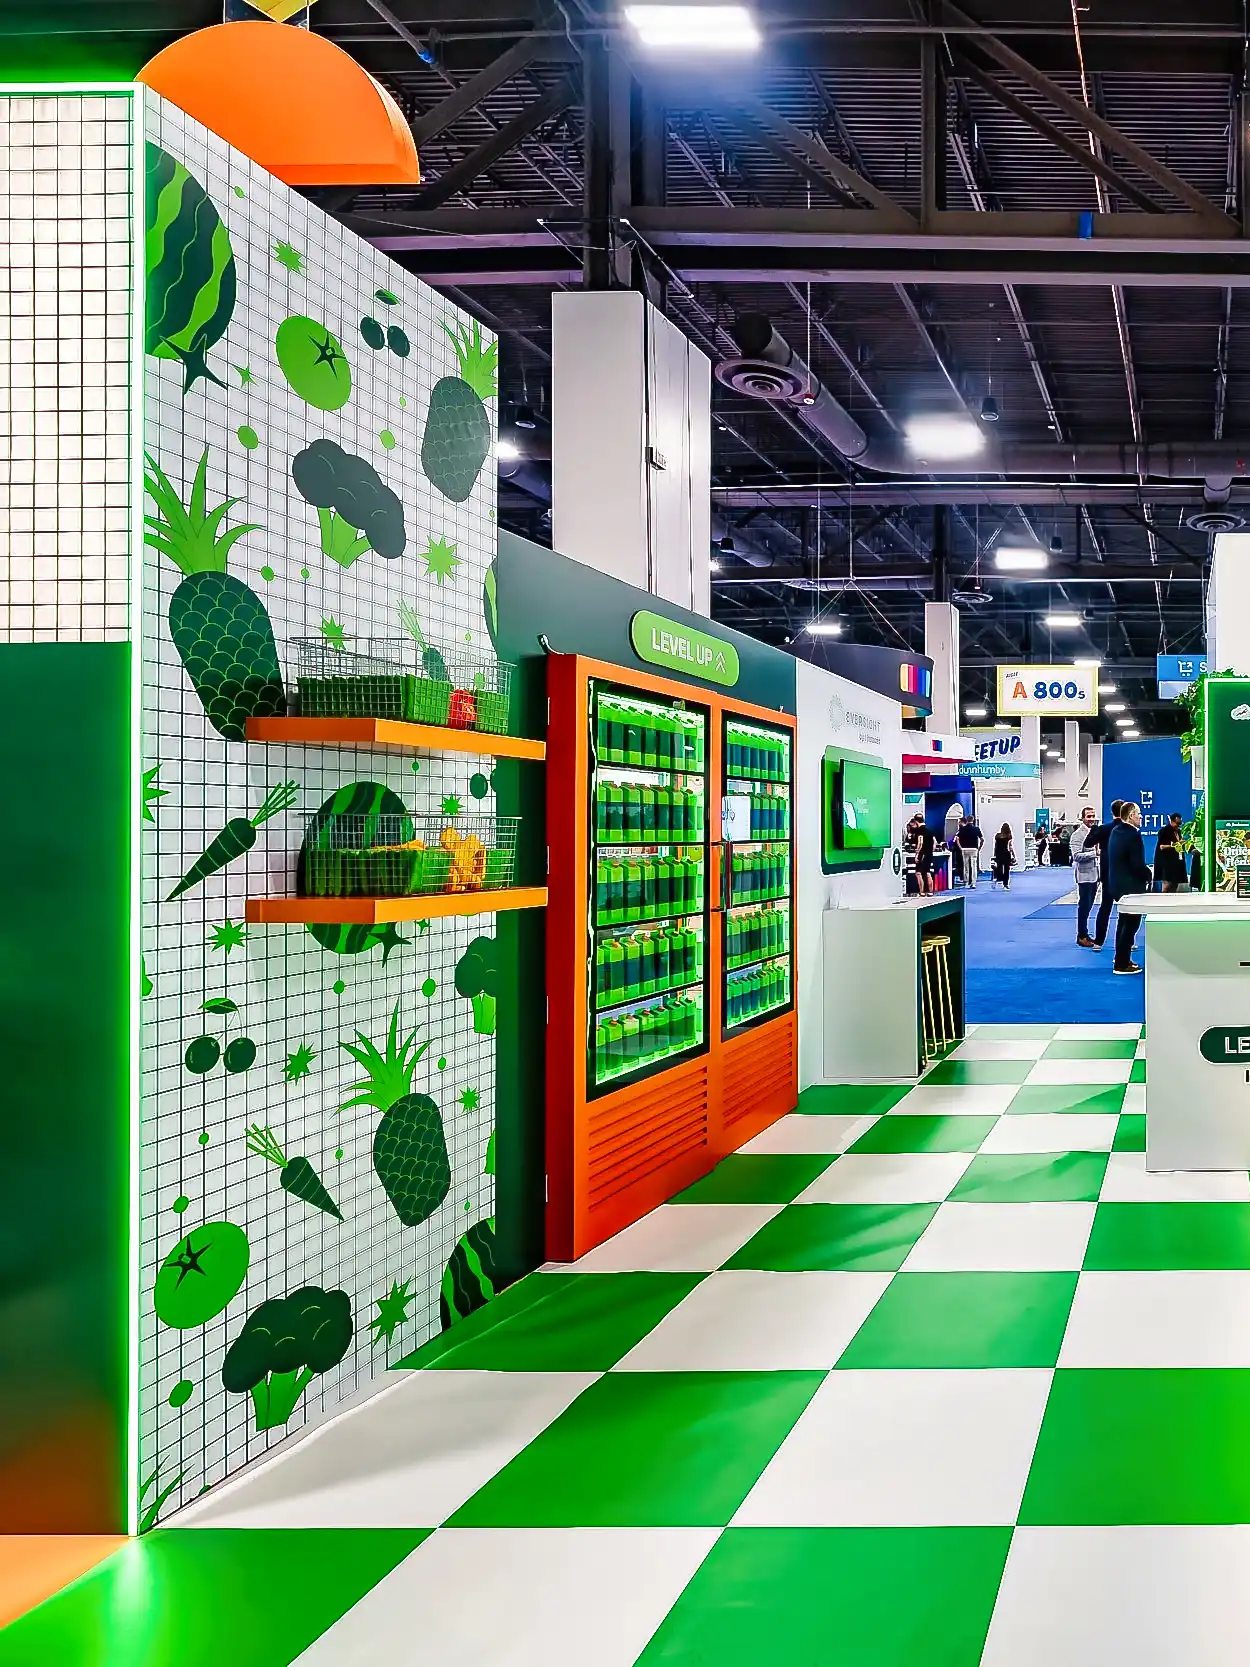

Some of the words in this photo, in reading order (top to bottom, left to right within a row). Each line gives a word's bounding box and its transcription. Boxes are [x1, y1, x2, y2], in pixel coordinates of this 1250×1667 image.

[652, 627, 694, 662] LEVEL
[696, 643, 713, 667] UP
[1012, 681, 1028, 699] A
[1033, 681, 1086, 700] 800s
[959, 765, 1006, 775] dunnhumby
